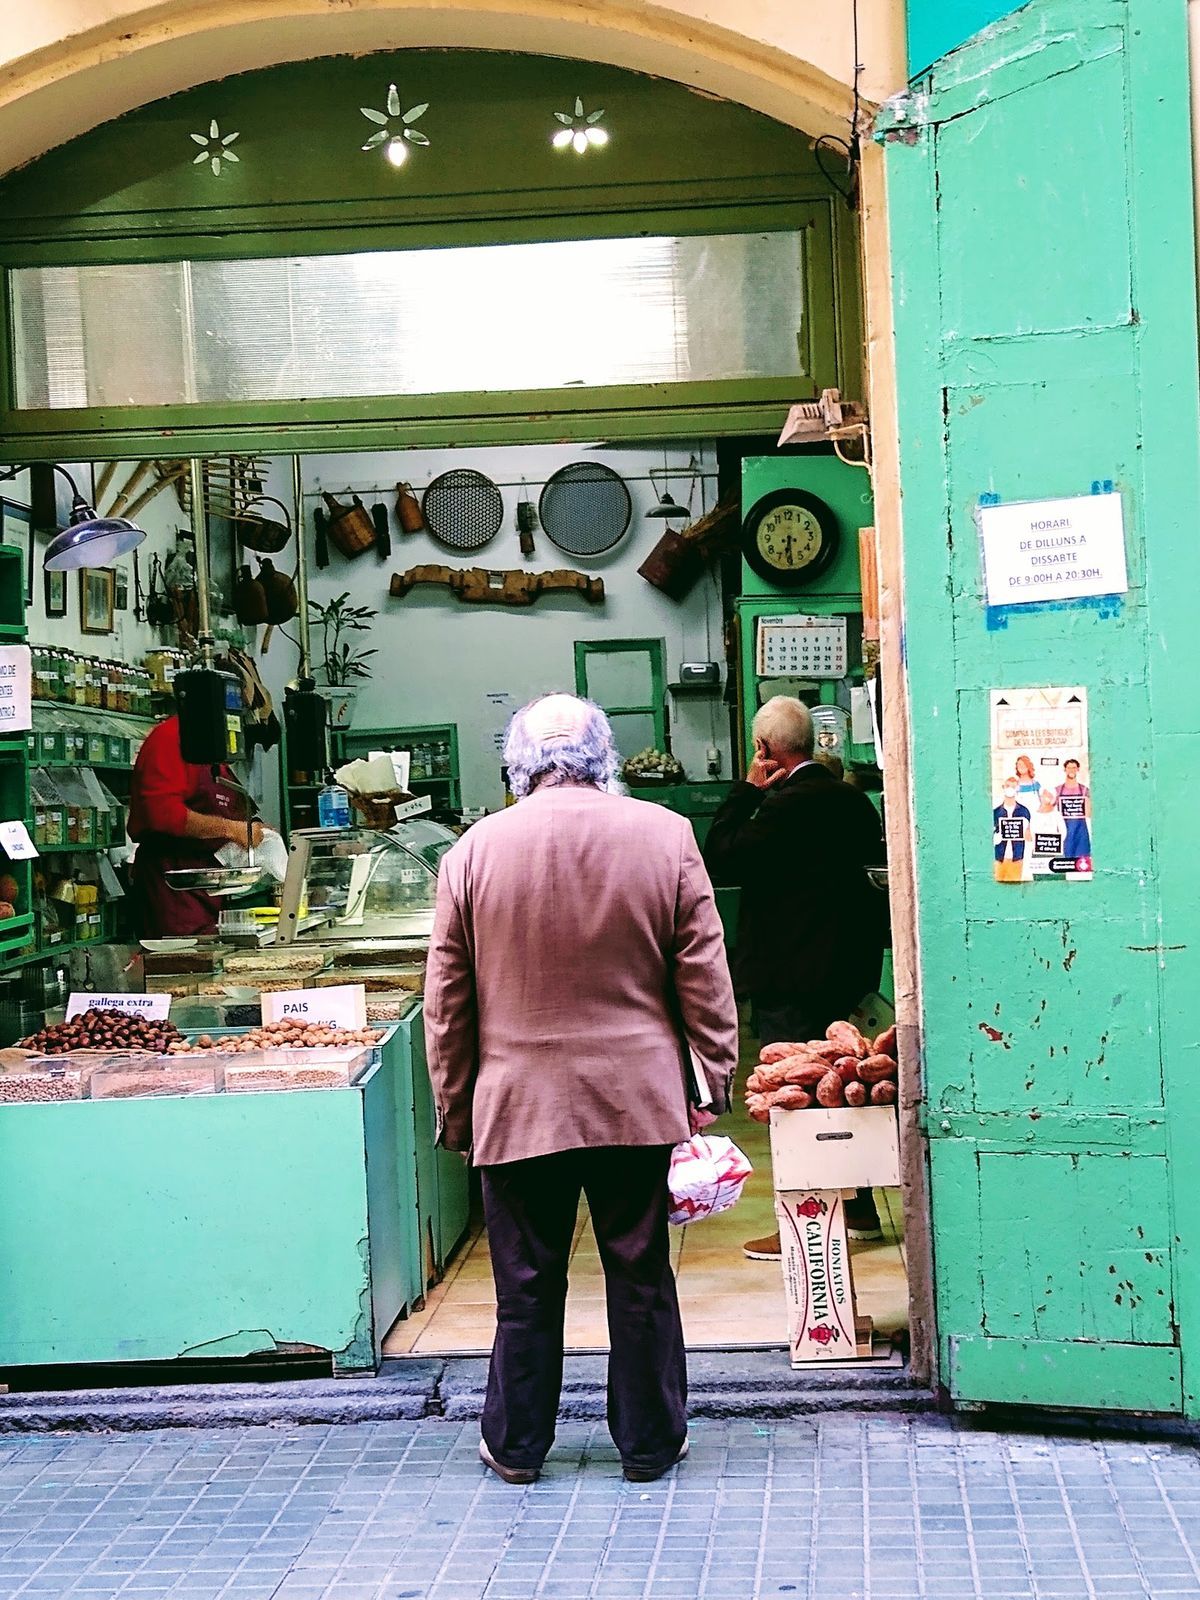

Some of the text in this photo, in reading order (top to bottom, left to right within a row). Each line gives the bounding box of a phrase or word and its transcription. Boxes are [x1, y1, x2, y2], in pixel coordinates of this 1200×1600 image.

[774, 515, 781, 524] 11
[784, 510, 792, 520] 12
[797, 513, 800, 523] 1
[766, 523, 775, 532] 10
[804, 521, 810, 530] 2
[1030, 518, 1069, 530] HORARI
[764, 534, 771, 543] 9
[808, 531, 814, 541] 3
[804, 543, 810, 551] 4
[1019, 535, 1087, 550] DE DILLUNS A
[768, 545, 774, 554] 8
[776, 552, 782, 561] 7
[797, 551, 804, 560] 5
[1031, 552, 1078, 566] DISSABTE
[1009, 577, 1021, 586] DE
[1055, 572, 1063, 580] A
[88, 997, 153, 1007] gallega extra
[283, 1003, 309, 1014] PAIS
[806, 1221, 829, 1321] CALIFORNIA
[832, 1239, 846, 1304] BONIATOS
